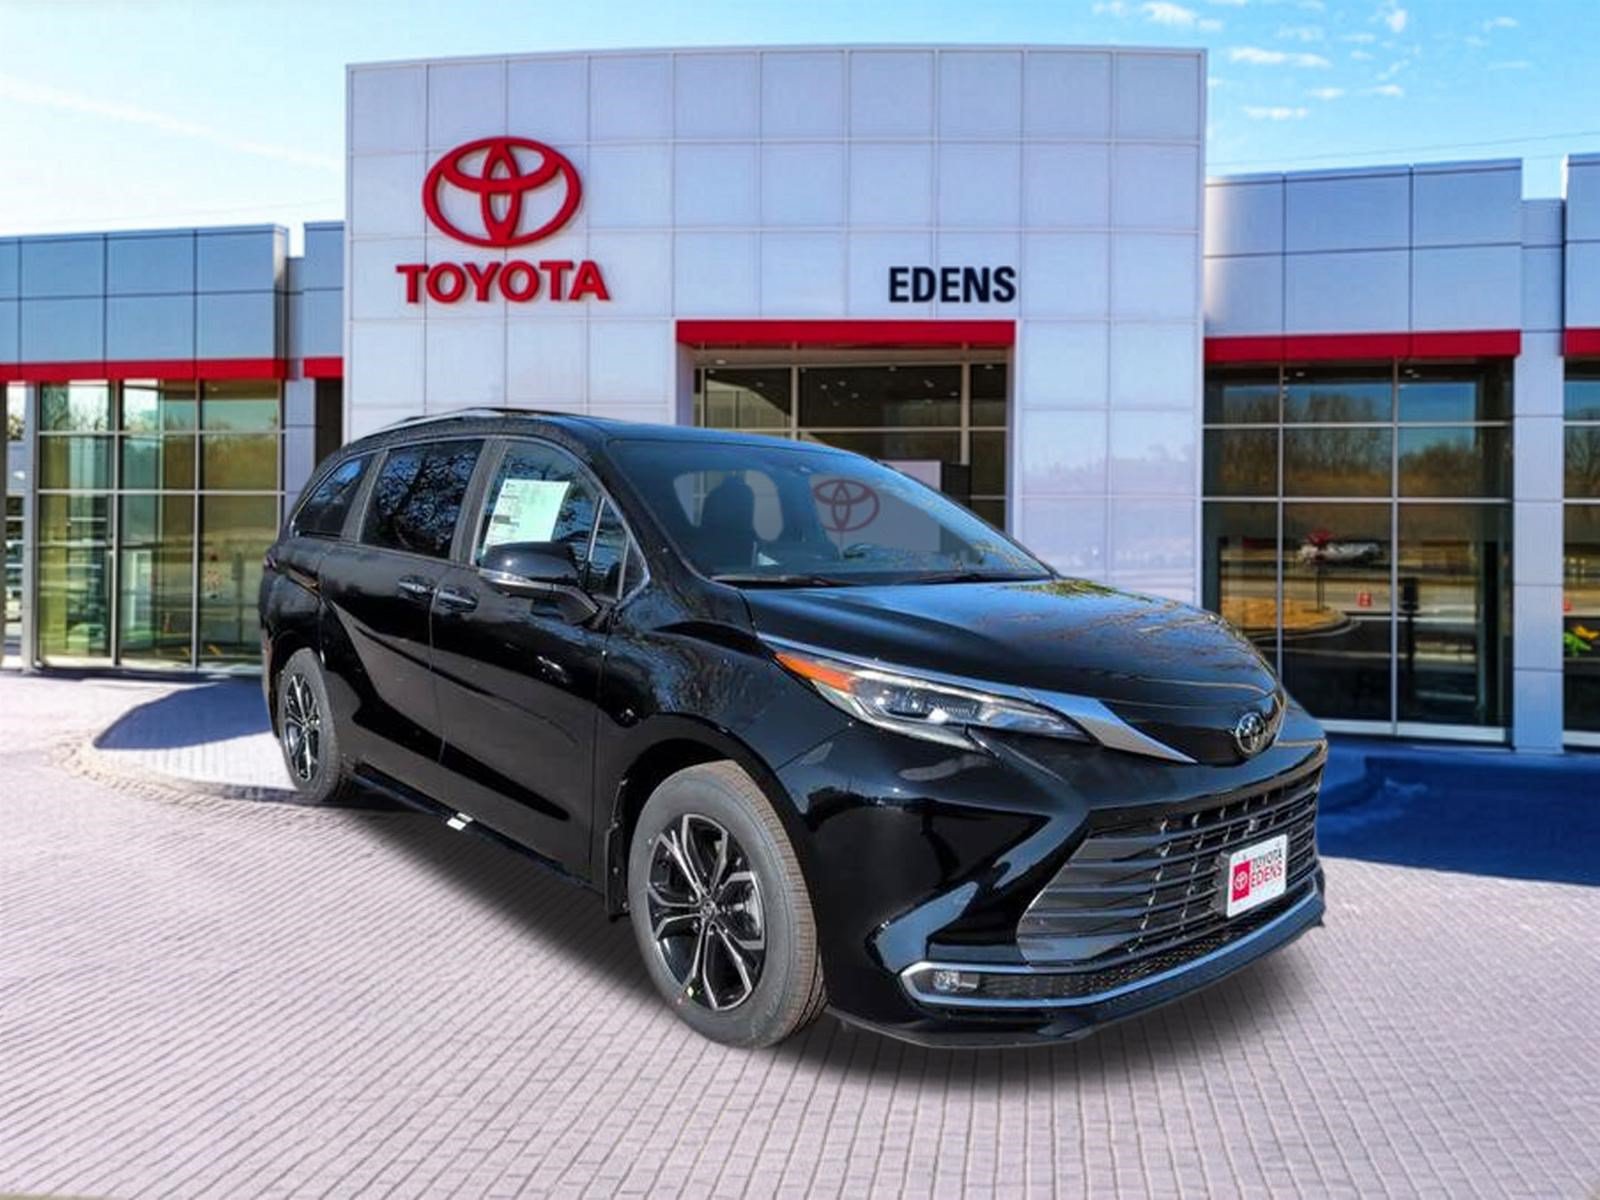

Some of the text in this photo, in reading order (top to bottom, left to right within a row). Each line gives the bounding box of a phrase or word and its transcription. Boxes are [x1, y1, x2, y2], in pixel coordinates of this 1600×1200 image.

[397, 260, 610, 304] TOYOTA
[889, 266, 1016, 302] EDENS
[1251, 863, 1283, 888] EDENS
